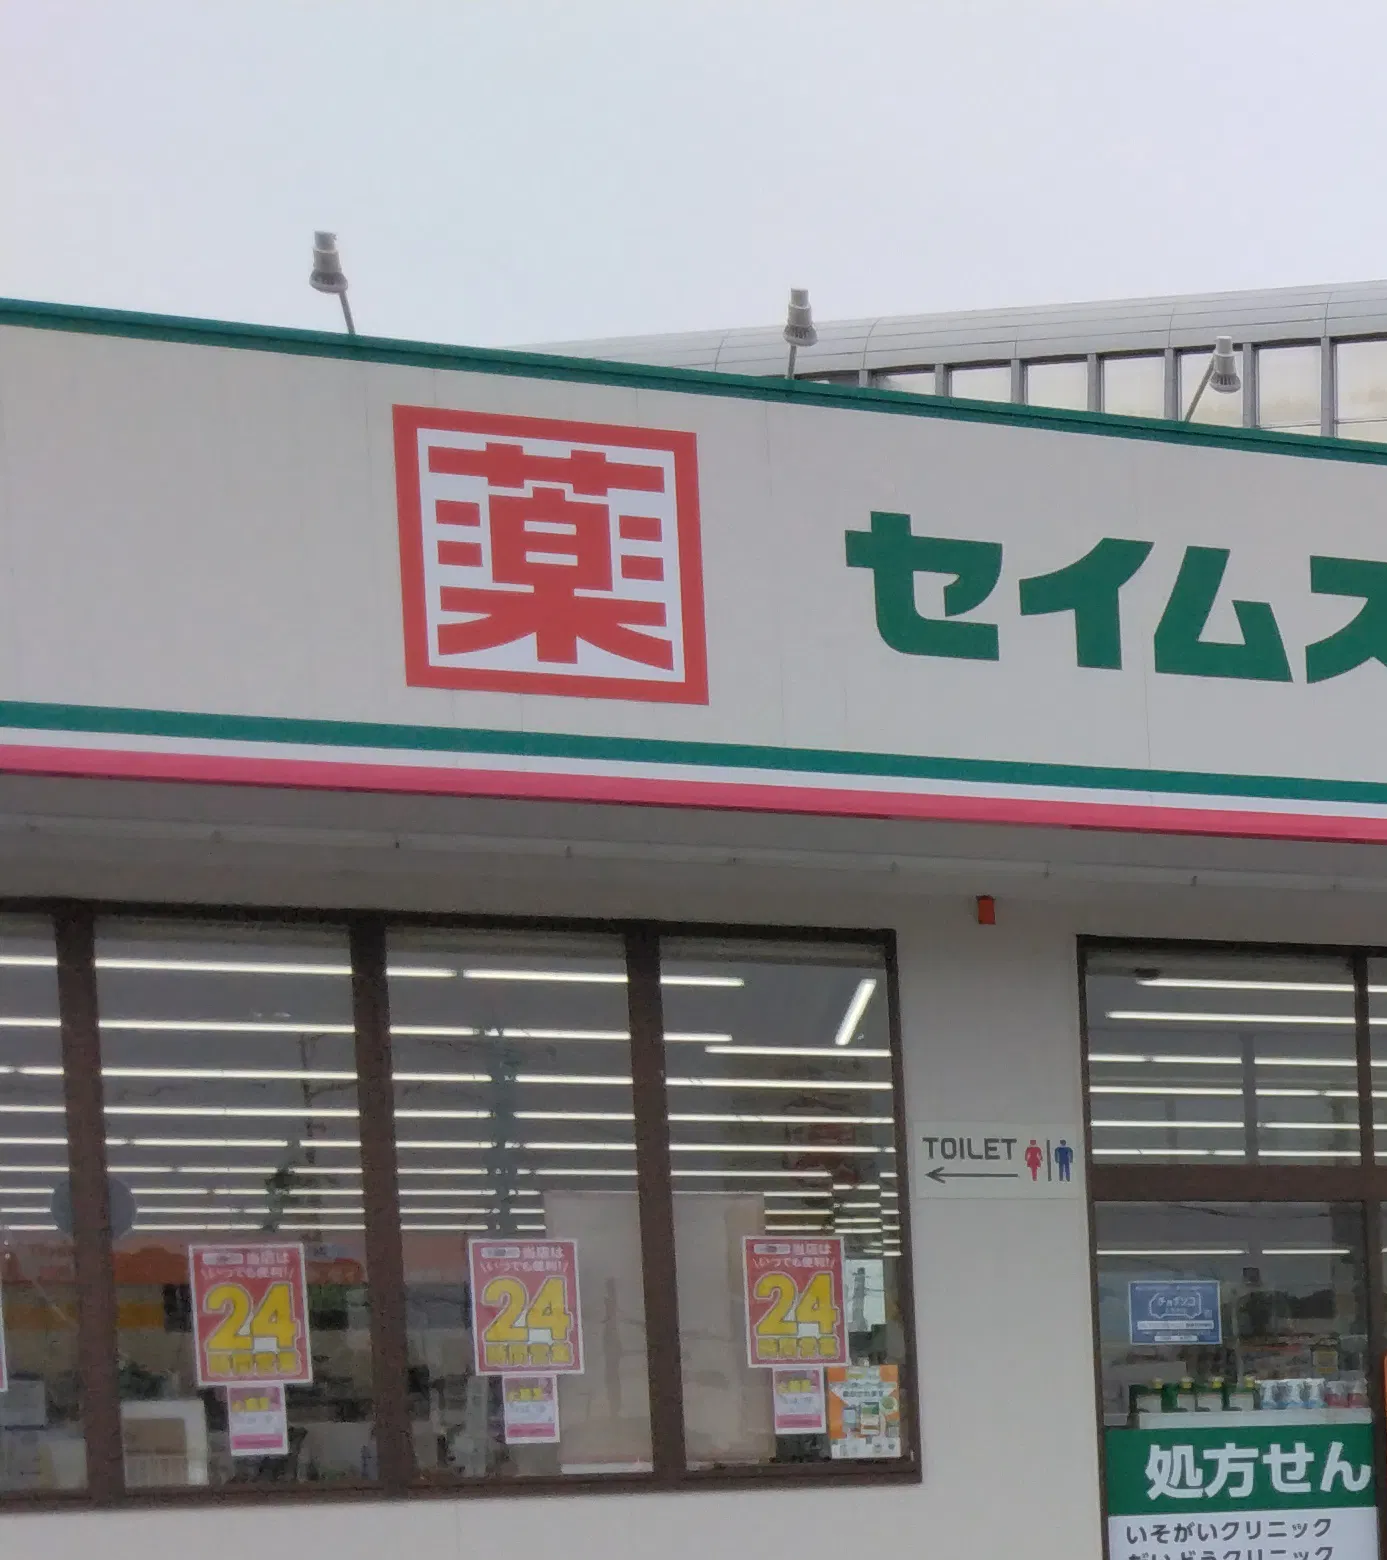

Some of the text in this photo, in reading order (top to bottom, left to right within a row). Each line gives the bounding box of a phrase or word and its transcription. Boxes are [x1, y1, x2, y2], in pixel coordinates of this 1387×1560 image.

[427, 441, 675, 671] 薬
[922, 1137, 1018, 1161] TOILET
[203, 1281, 301, 1350] 24
[482, 1275, 574, 1342] 24
[754, 1270, 840, 1336] 24
[1144, 1441, 1372, 1501] 処方せん
[1126, 1518, 1332, 1545] いそがいクリニック
